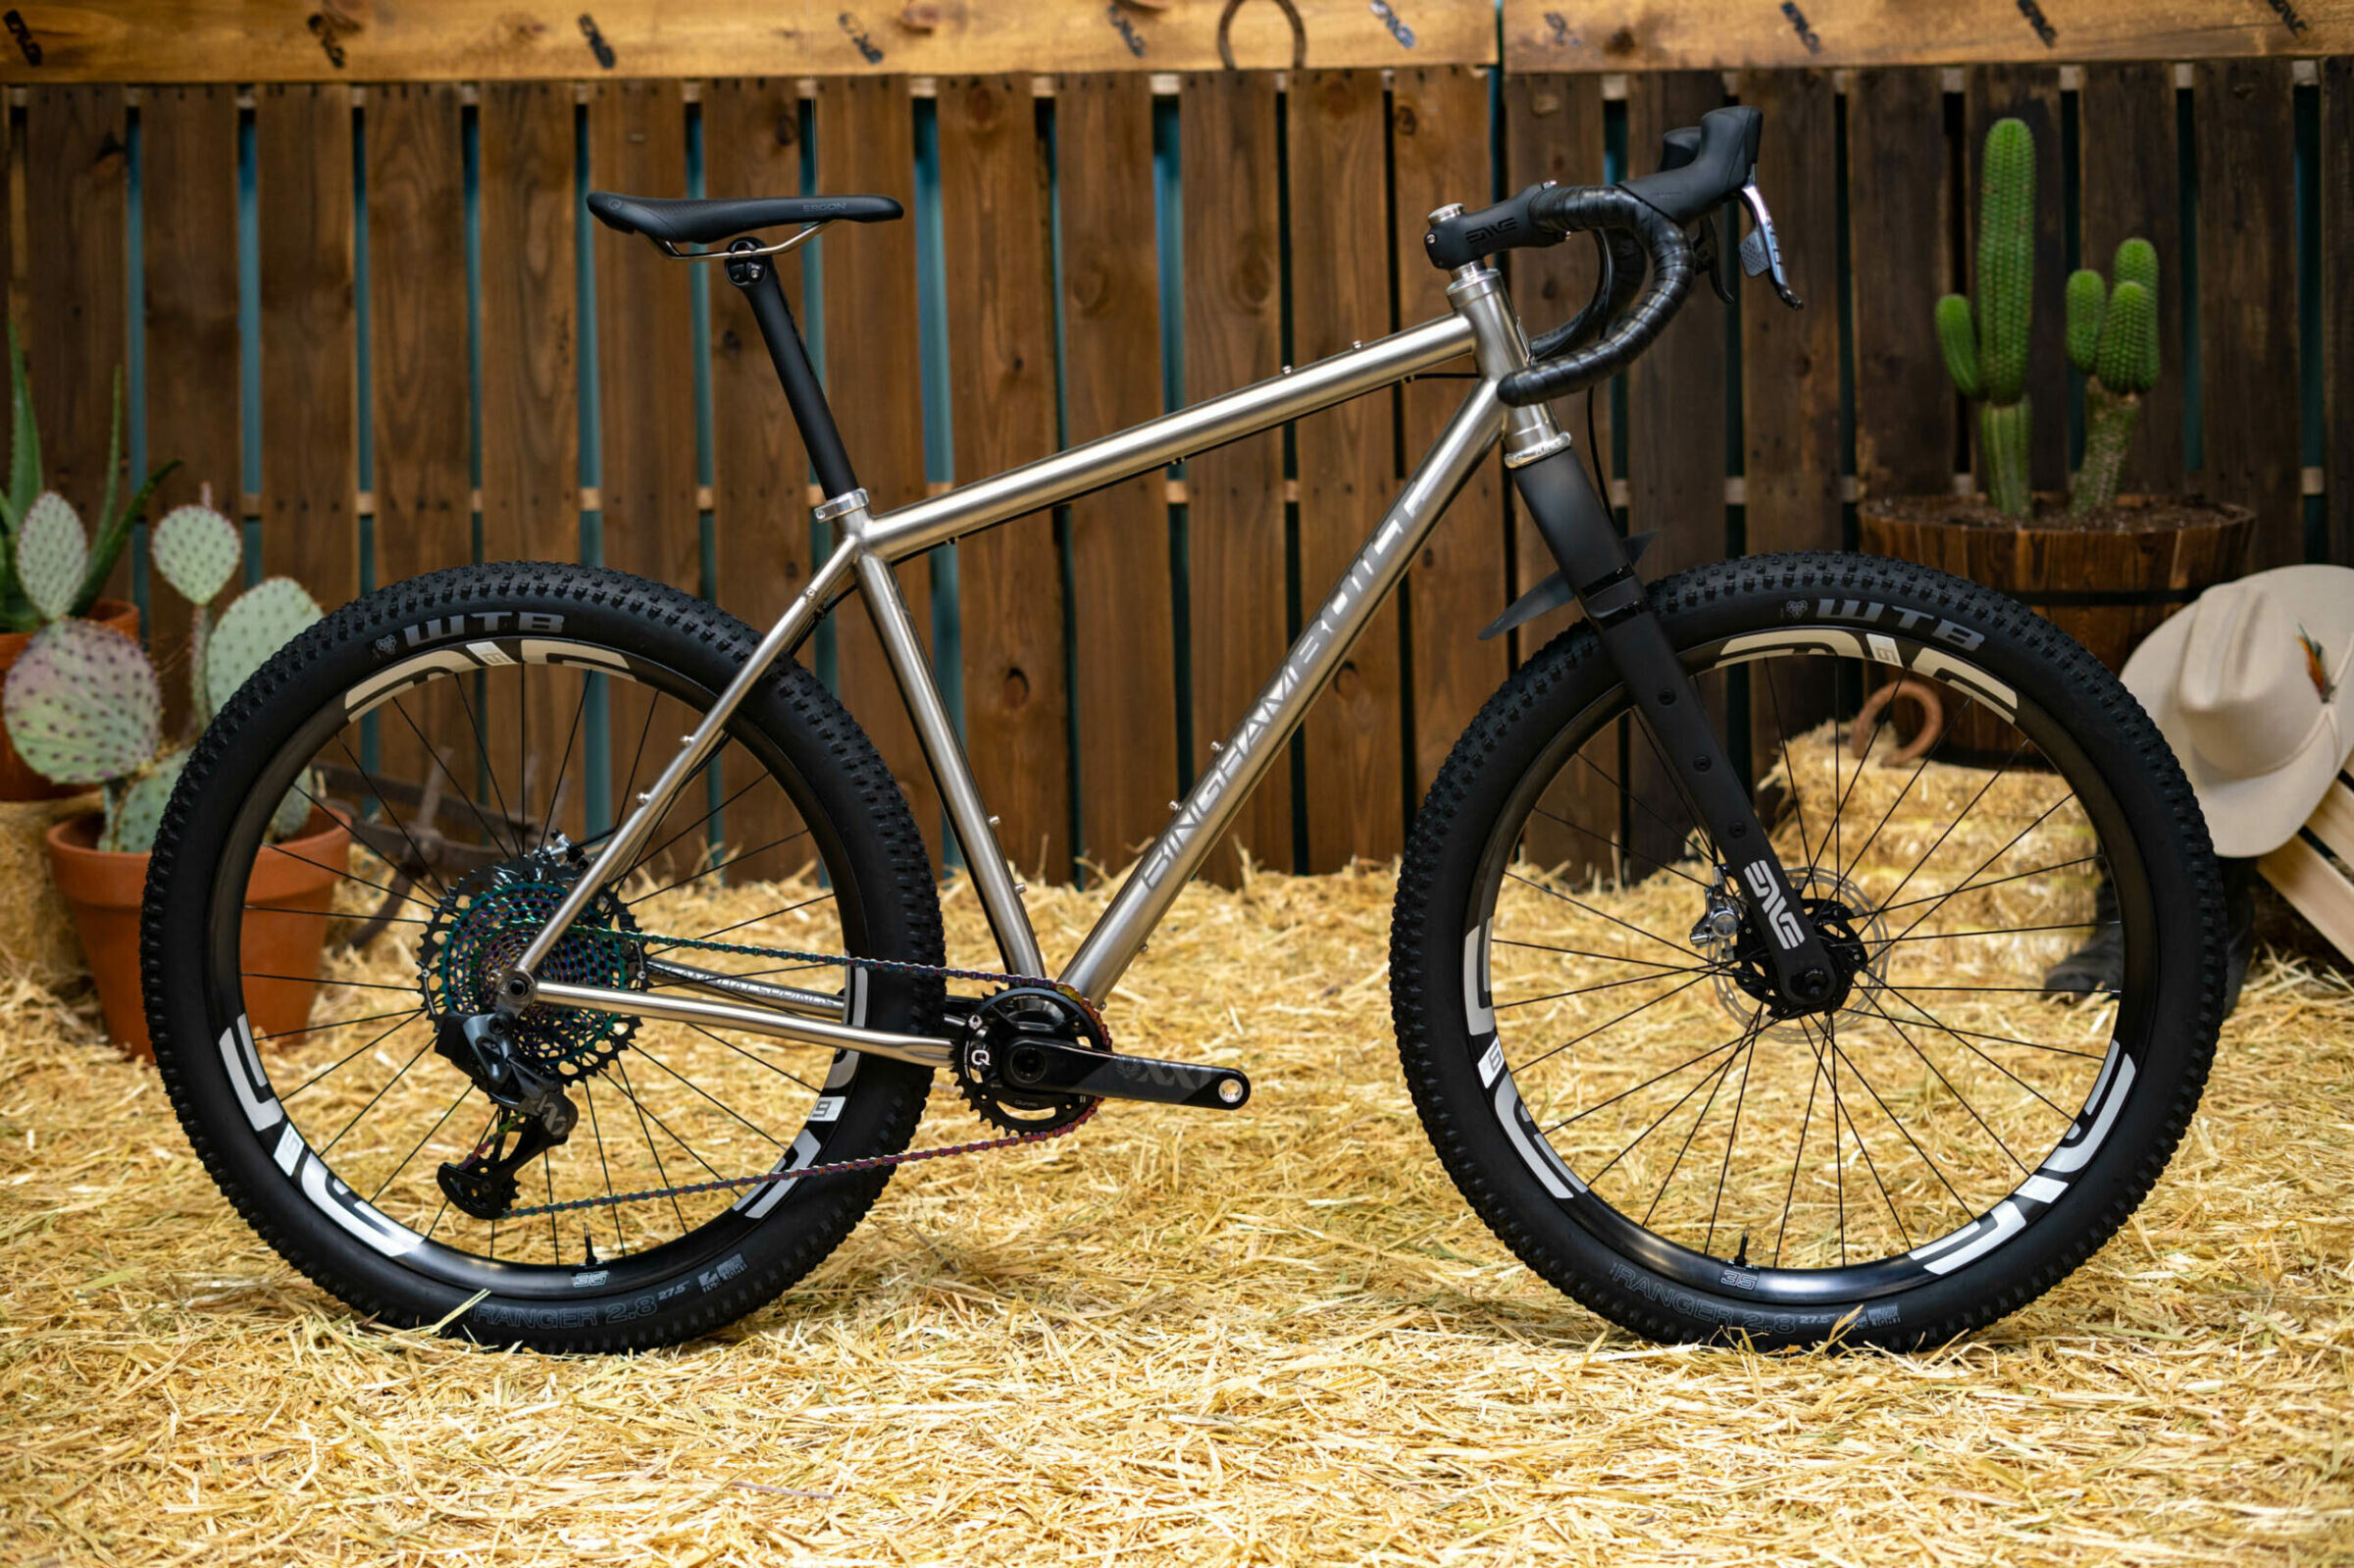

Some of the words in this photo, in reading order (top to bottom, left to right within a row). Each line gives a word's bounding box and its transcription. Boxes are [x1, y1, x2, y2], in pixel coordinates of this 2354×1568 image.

[802, 202, 846, 213] ERGON
[1139, 661, 1304, 893] BINGHAM
[1299, 478, 1432, 667] BUILT
[572, 1270, 609, 1289] 35
[1718, 1269, 1760, 1290] 35
[474, 1303, 597, 1330] RANGER
[605, 1294, 659, 1324] 2.8
[1612, 1262, 1734, 1328] RANGER
[1740, 1312, 1797, 1335] 2.8
